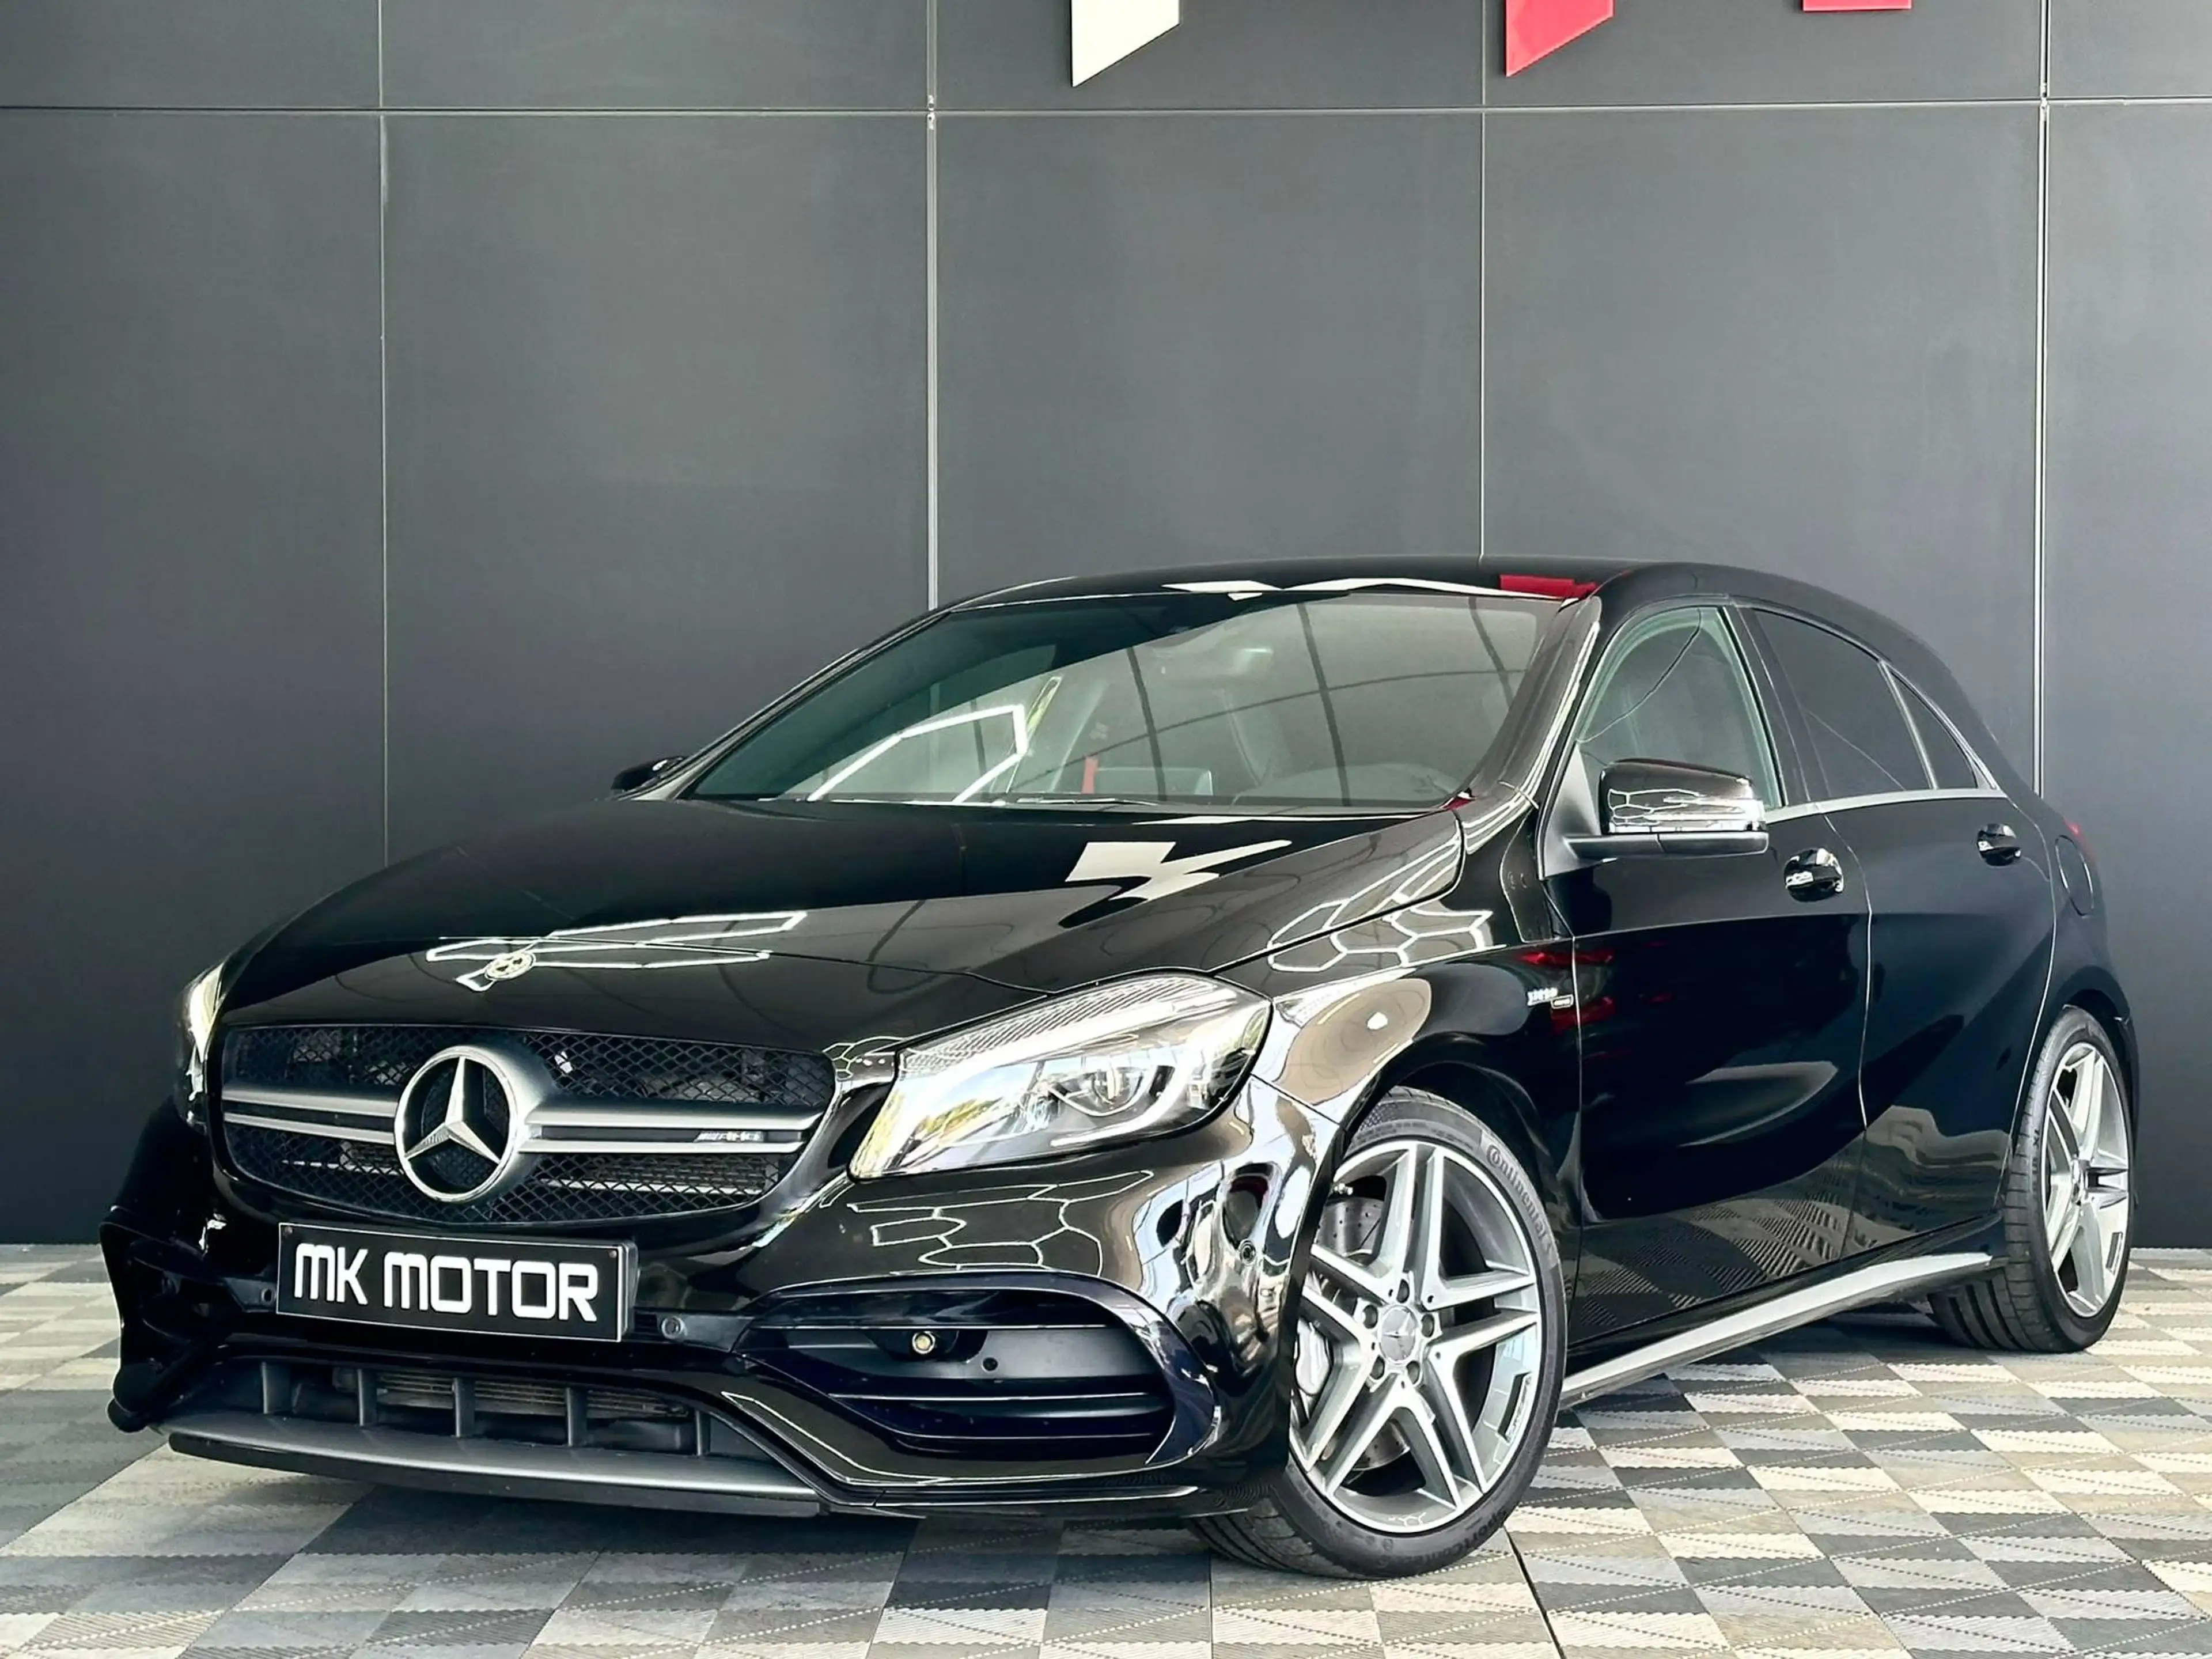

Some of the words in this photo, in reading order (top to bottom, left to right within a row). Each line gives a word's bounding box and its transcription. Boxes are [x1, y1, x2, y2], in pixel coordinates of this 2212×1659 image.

[1486, 1143, 1547, 1240] Continental
[294, 1243, 368, 1305] MK
[384, 1251, 598, 1321] MOTOR
